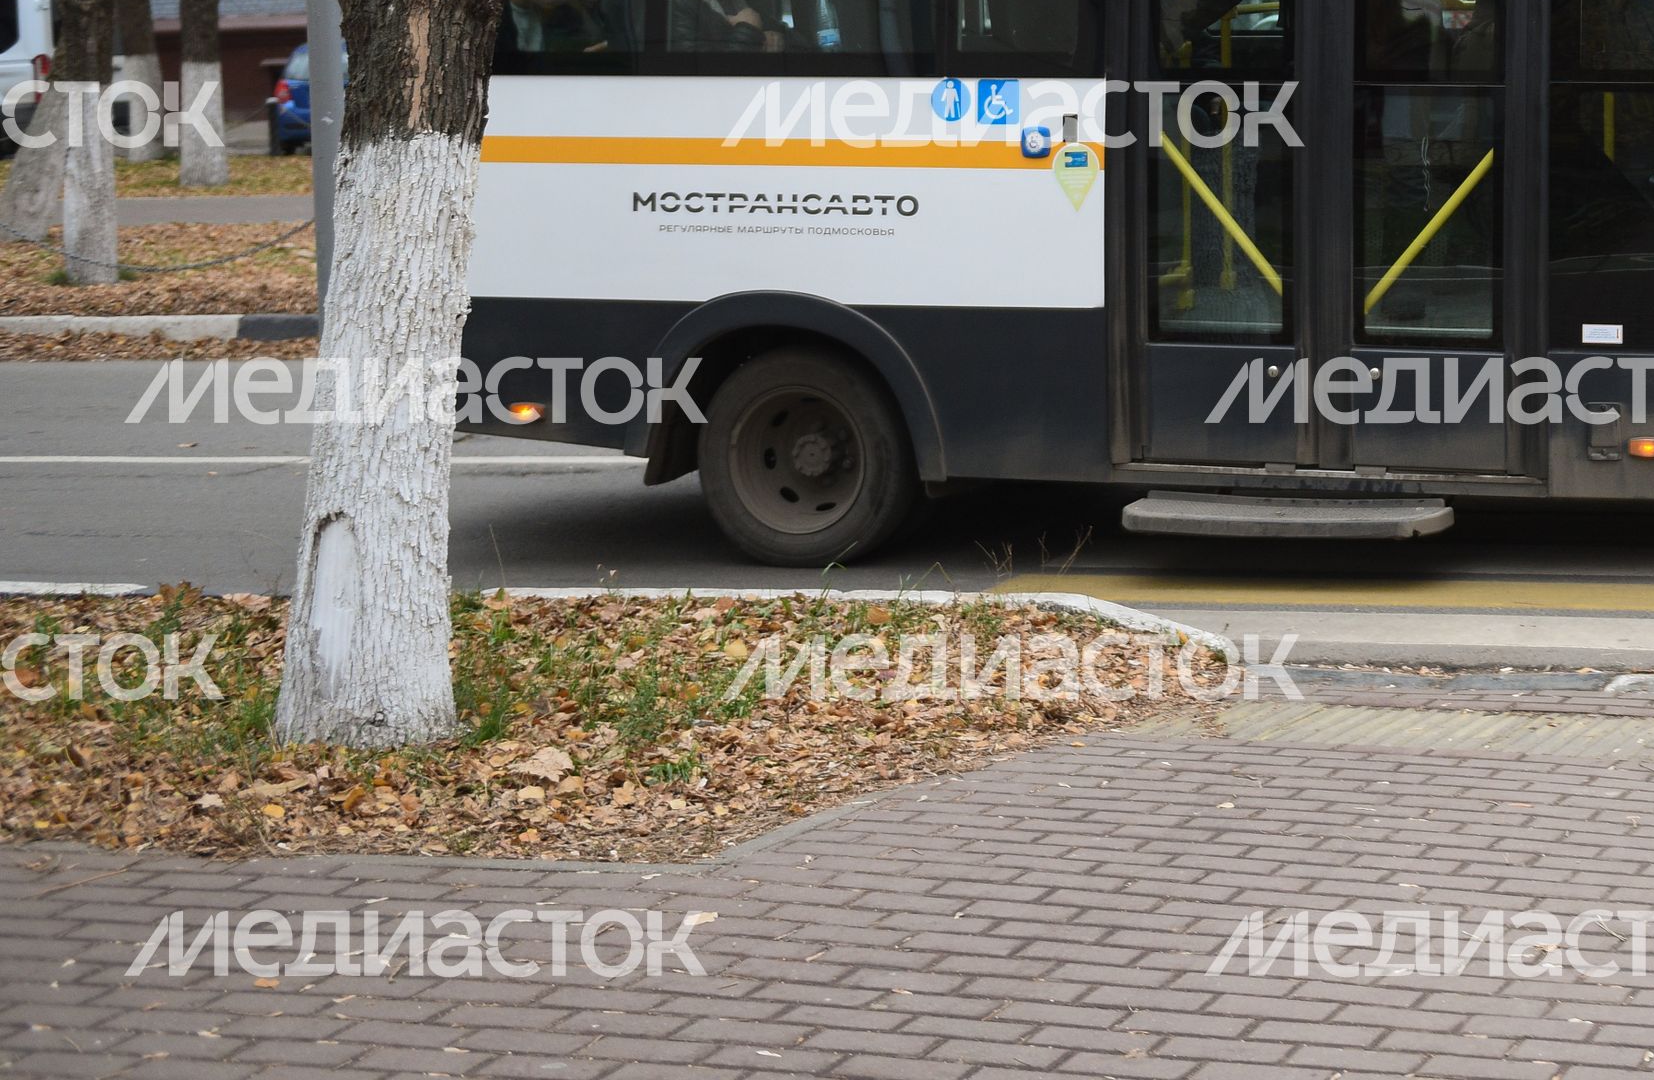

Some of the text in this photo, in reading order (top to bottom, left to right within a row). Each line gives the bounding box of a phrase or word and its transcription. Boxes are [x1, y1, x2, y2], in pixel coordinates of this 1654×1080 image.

[632, 191, 919, 217] МОСТРАНСАВТО
[659, 224, 895, 236] РЕГУЛЯРНЫЕ МАРШРУТЫ ПОДМОСКОВЬЯ
